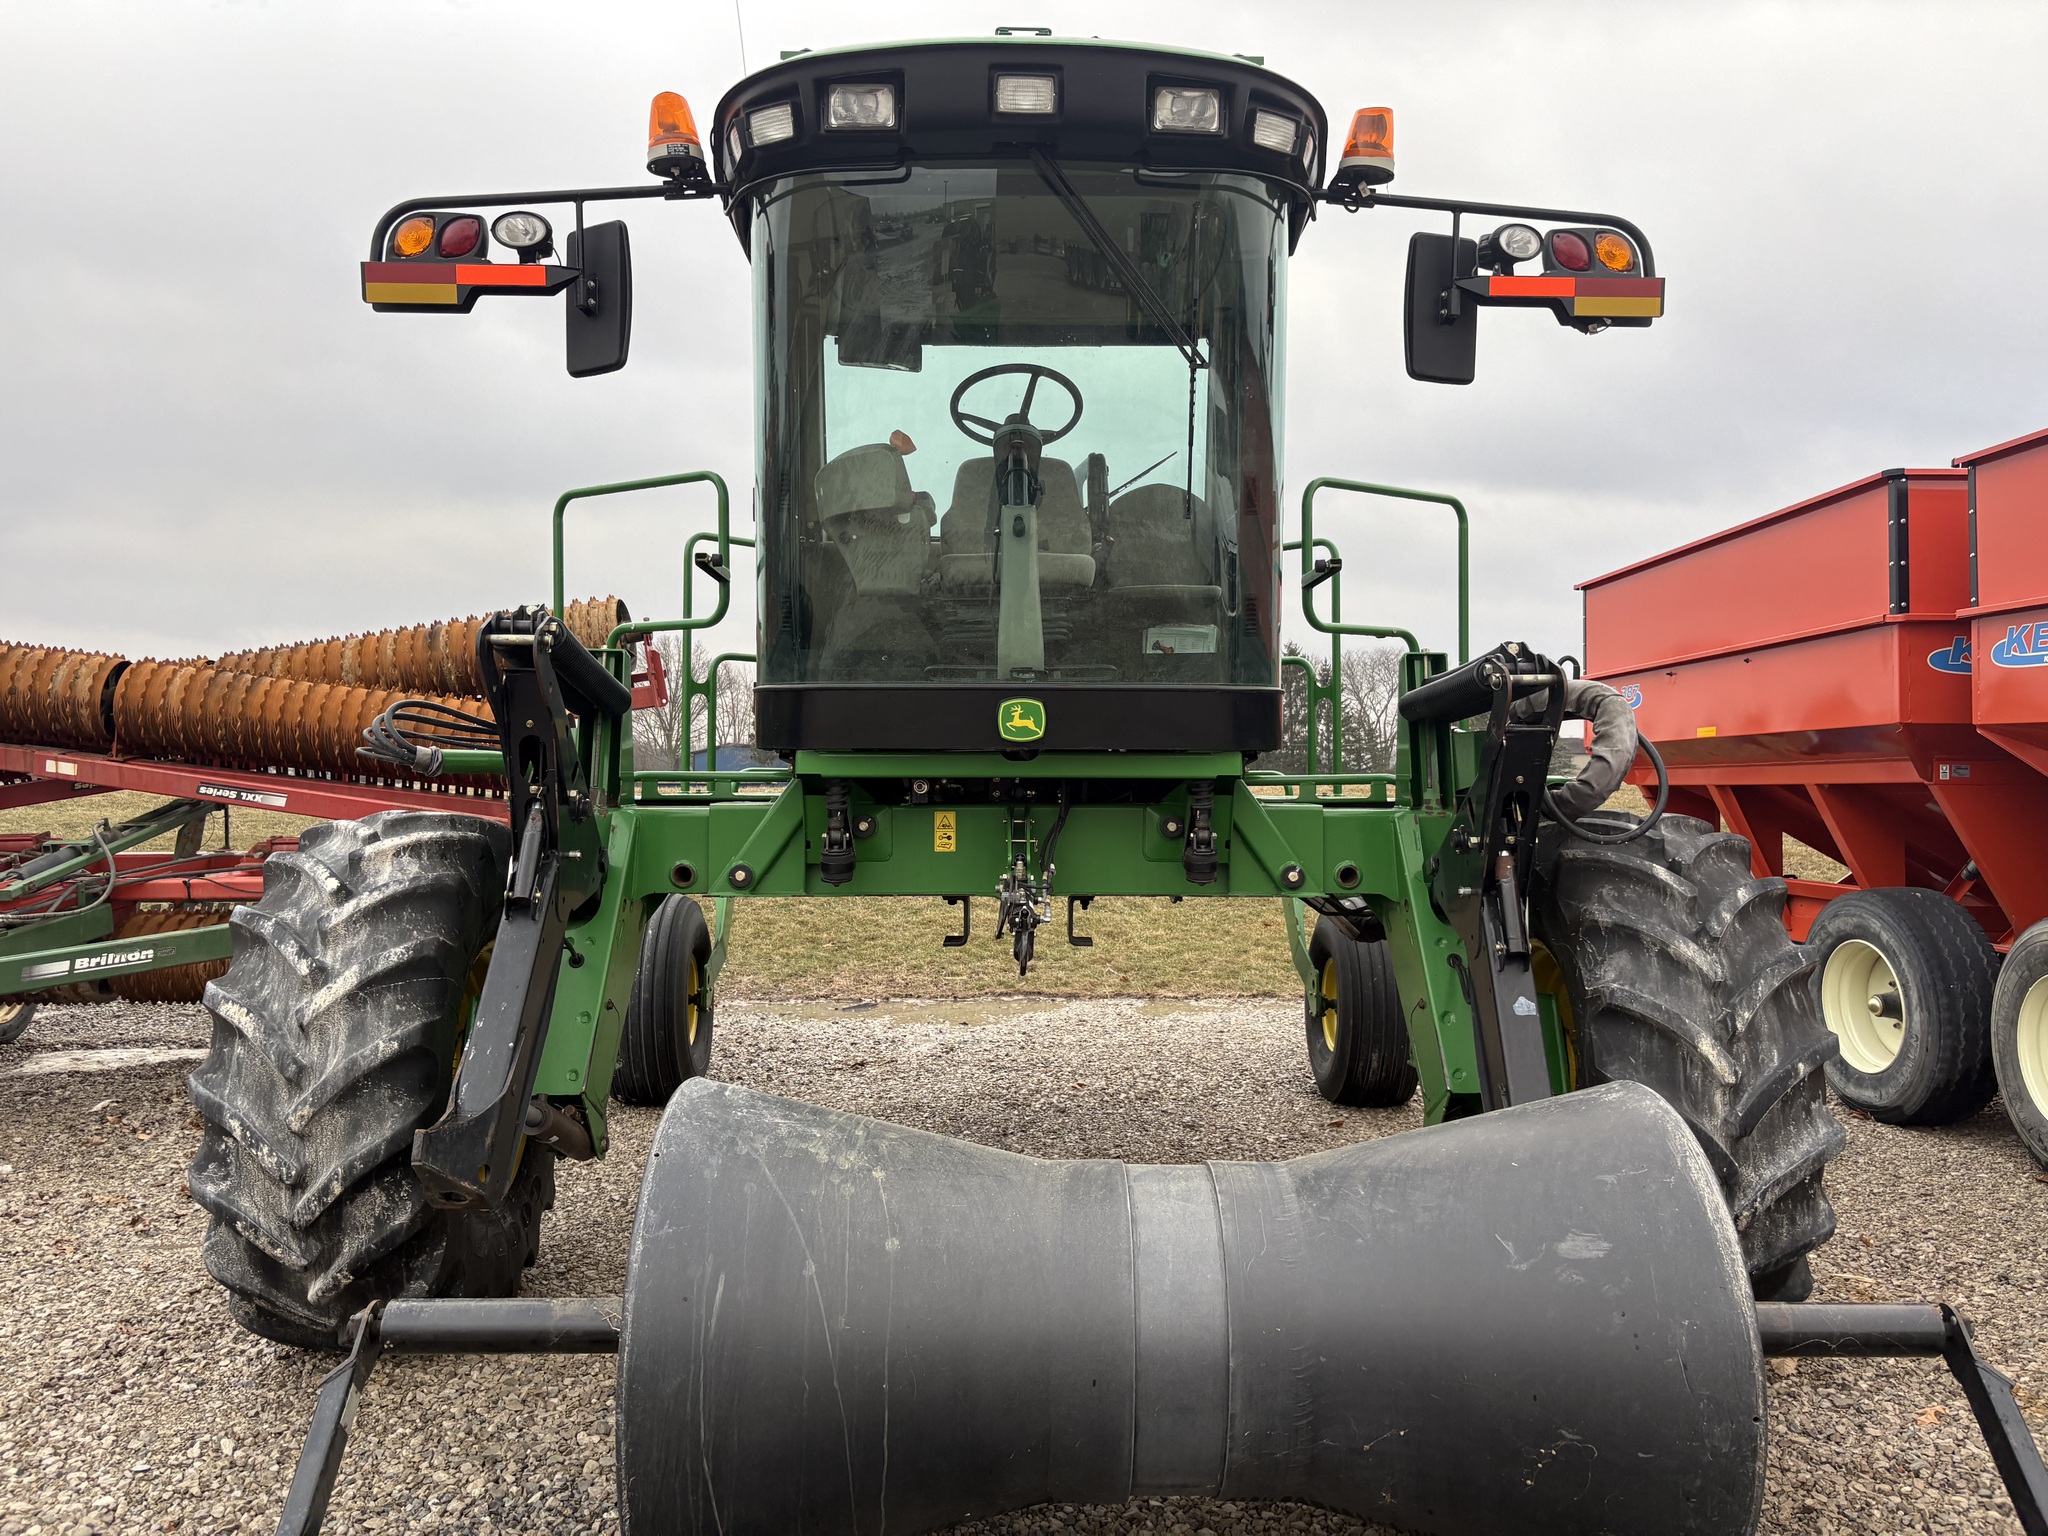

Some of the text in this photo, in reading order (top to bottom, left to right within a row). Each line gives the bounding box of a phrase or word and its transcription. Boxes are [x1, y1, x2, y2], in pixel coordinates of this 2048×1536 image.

[1948, 636, 1972, 664] K
[198, 786, 263, 802] XXL Series
